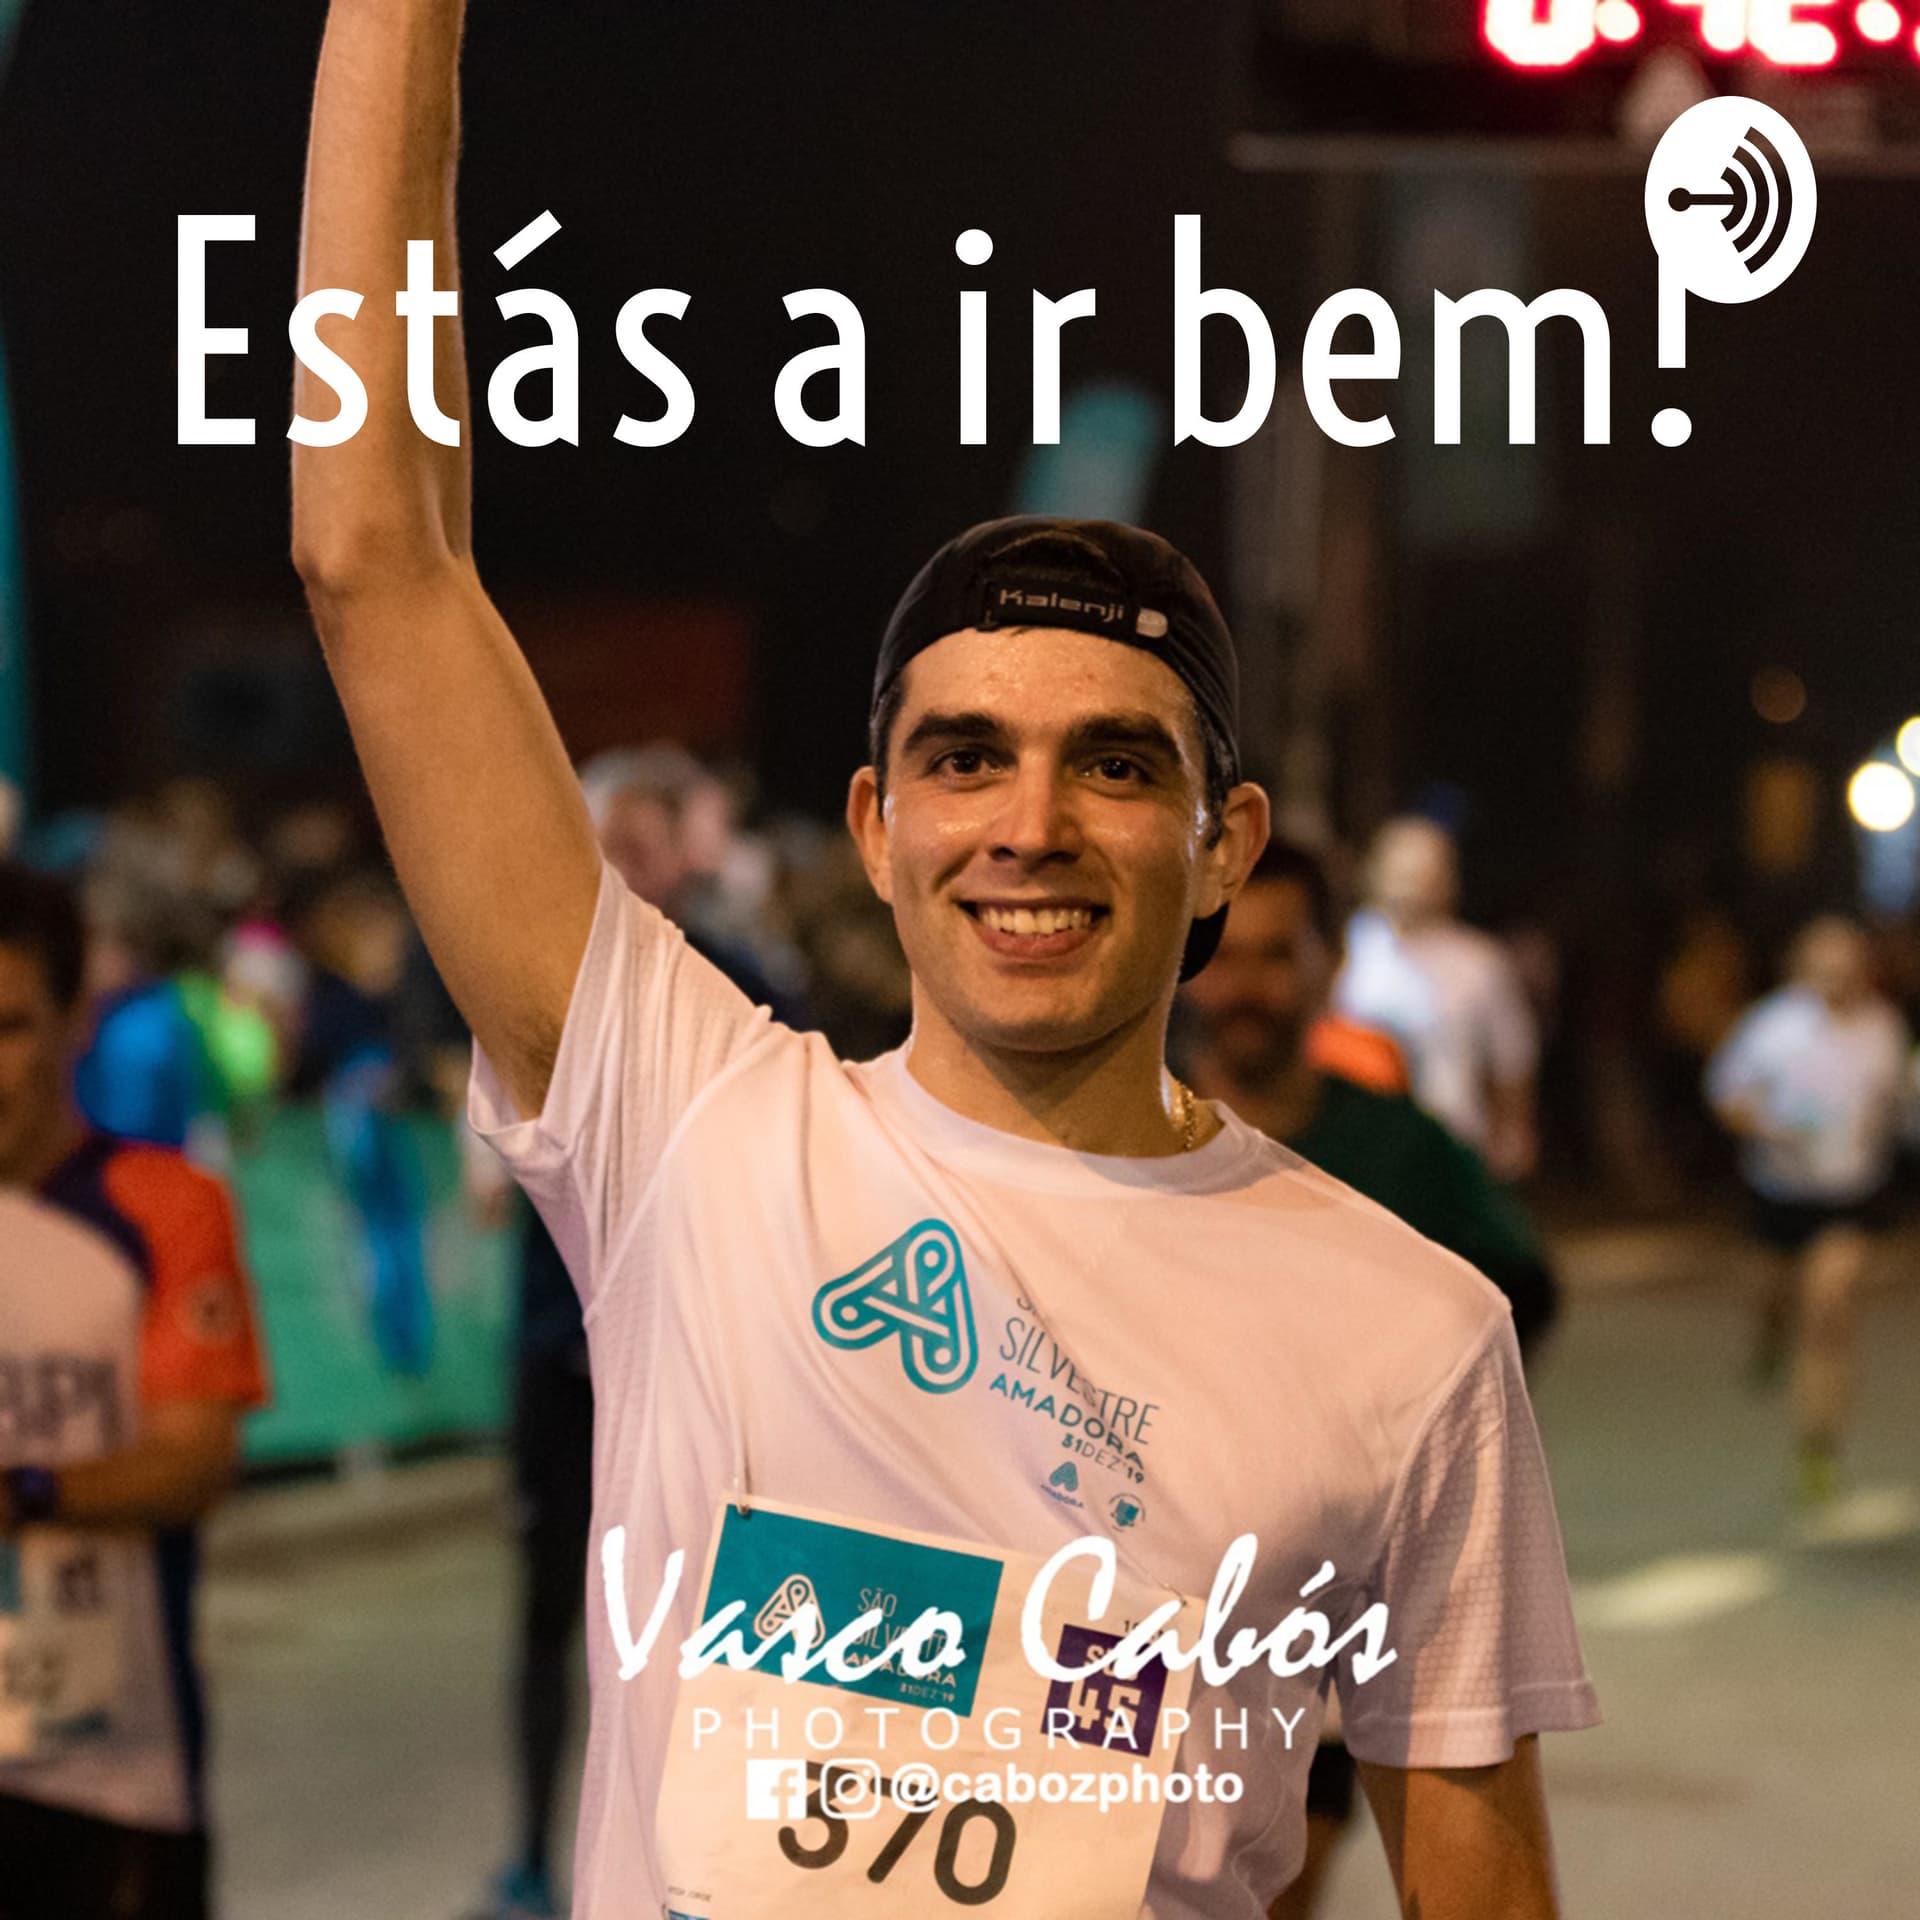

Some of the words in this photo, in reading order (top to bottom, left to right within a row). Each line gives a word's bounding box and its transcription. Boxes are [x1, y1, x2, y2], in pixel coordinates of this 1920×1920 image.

[999, 589, 1125, 623] Kalenji
[989, 1373, 1144, 1470] AMADORA
[1067, 1677, 1143, 1740] 45
